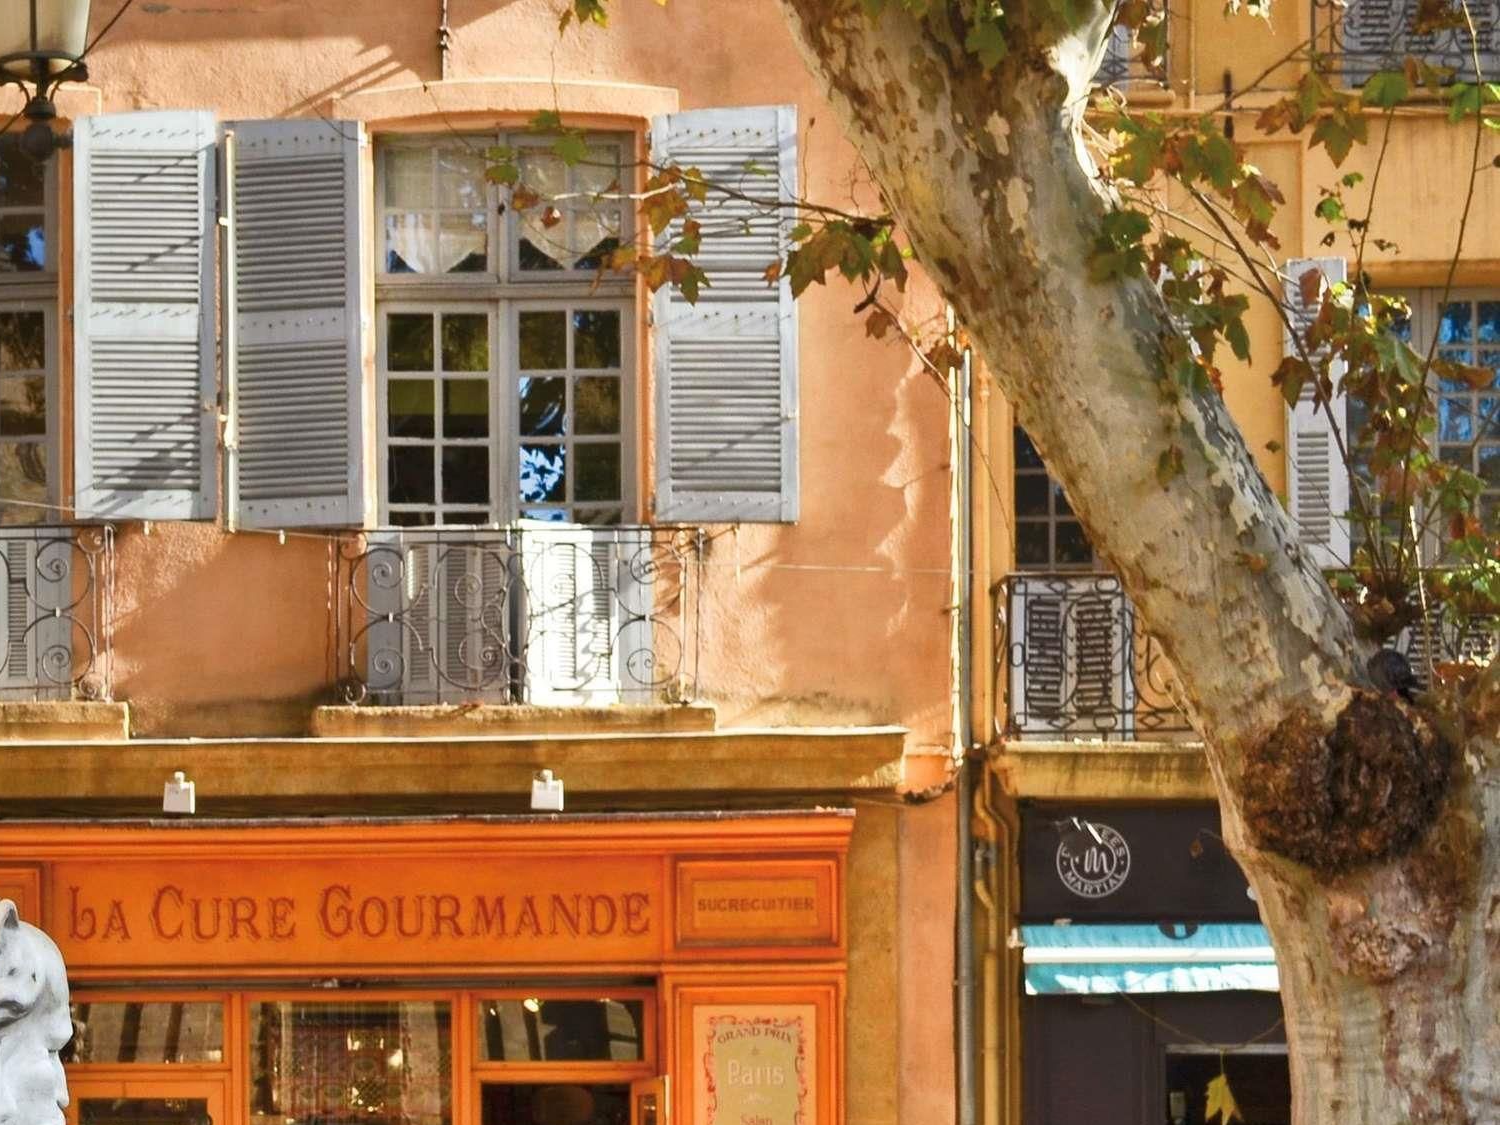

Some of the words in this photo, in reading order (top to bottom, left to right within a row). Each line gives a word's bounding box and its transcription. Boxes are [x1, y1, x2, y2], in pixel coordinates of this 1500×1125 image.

[1063, 869, 1127, 895] MARTIAL
[68, 884, 132, 942] LA
[150, 884, 298, 942] CURE
[318, 884, 651, 940] GOURMANDE
[716, 1026, 761, 1045] GRAND
[764, 1026, 794, 1045] PRIX
[727, 1059, 785, 1087] Paris
